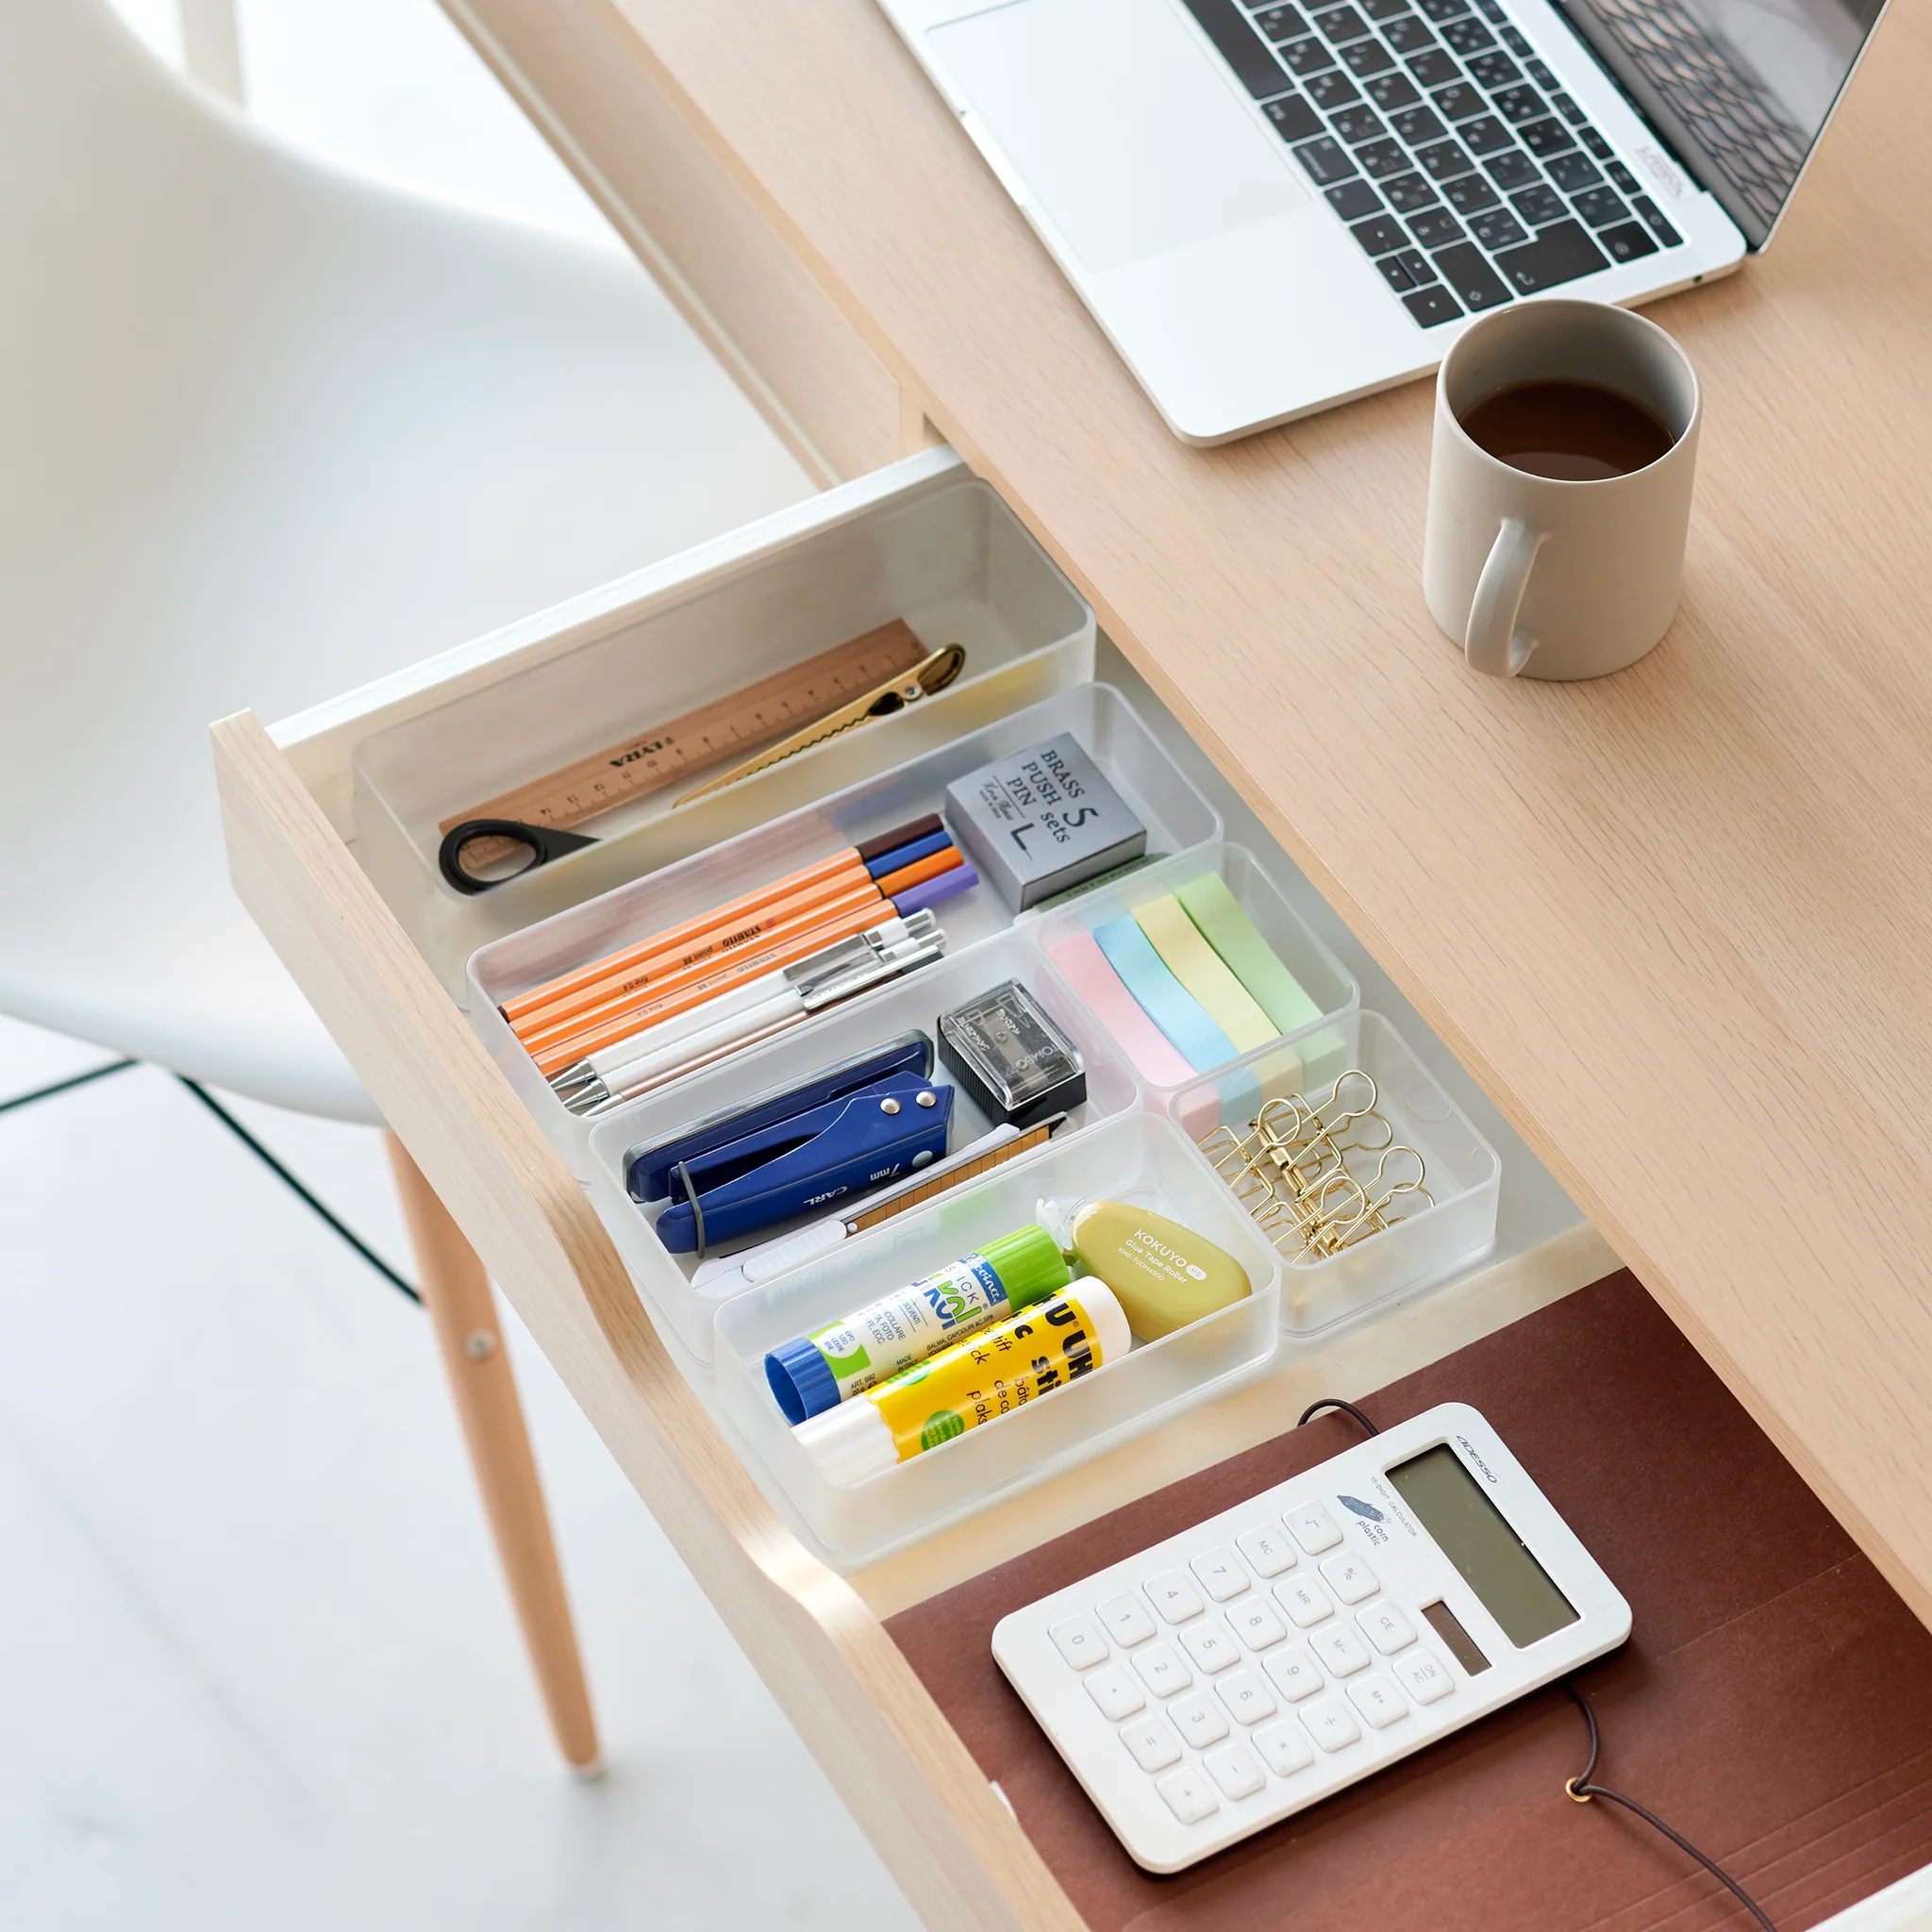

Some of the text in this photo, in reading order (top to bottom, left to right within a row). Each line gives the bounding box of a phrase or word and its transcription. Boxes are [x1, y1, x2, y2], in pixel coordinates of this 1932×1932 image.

[608, 742, 663, 769] LYRA
[1041, 750, 1085, 798] BRASS
[1023, 761, 1062, 806] PUSH
[1007, 777, 1037, 807] PIN
[1062, 808, 1100, 827] 5
[1041, 812, 1071, 843] sets
[723, 925, 761, 946] STABILO
[682, 955, 692, 965] 88
[692, 946, 713, 961] point
[737, 953, 775, 973] STABILO
[632, 974, 648, 986] fine
[867, 1162, 903, 1183] 7mm
[801, 1184, 849, 1207] CARL
[1134, 1229, 1187, 1268] KOKUYO
[1125, 1239, 1188, 1284] Glue Tape Roller
[879, 1322, 894, 1341] FOTO
[896, 1354, 912, 1366] MADE
[1062, 1330, 1093, 1380] UH
[1457, 1435, 1497, 1484] ADESSO
[1370, 1476, 1418, 1538] 10-DIGIT CALCULATOR
[1357, 1520, 1381, 1546] plastic
[1374, 1524, 1389, 1542] corn
[1258, 1541, 1274, 1556] MC
[1213, 1566, 1226, 1575] 7
[1168, 1591, 1179, 1599] 4
[1295, 1590, 1310, 1605] MR
[1249, 1616, 1262, 1626] 8
[1380, 1617, 1394, 1631] CE
[1072, 1635, 1084, 1645] 0
[1203, 1640, 1217, 1650] 5
[1154, 1663, 1168, 1674] 2
[1287, 1666, 1300, 1676] 9
[1424, 1664, 1438, 1678] ON
[1412, 1672, 1424, 1684] AC
[1240, 1690, 1253, 1701] 6
[1192, 1713, 1206, 1724] 3
